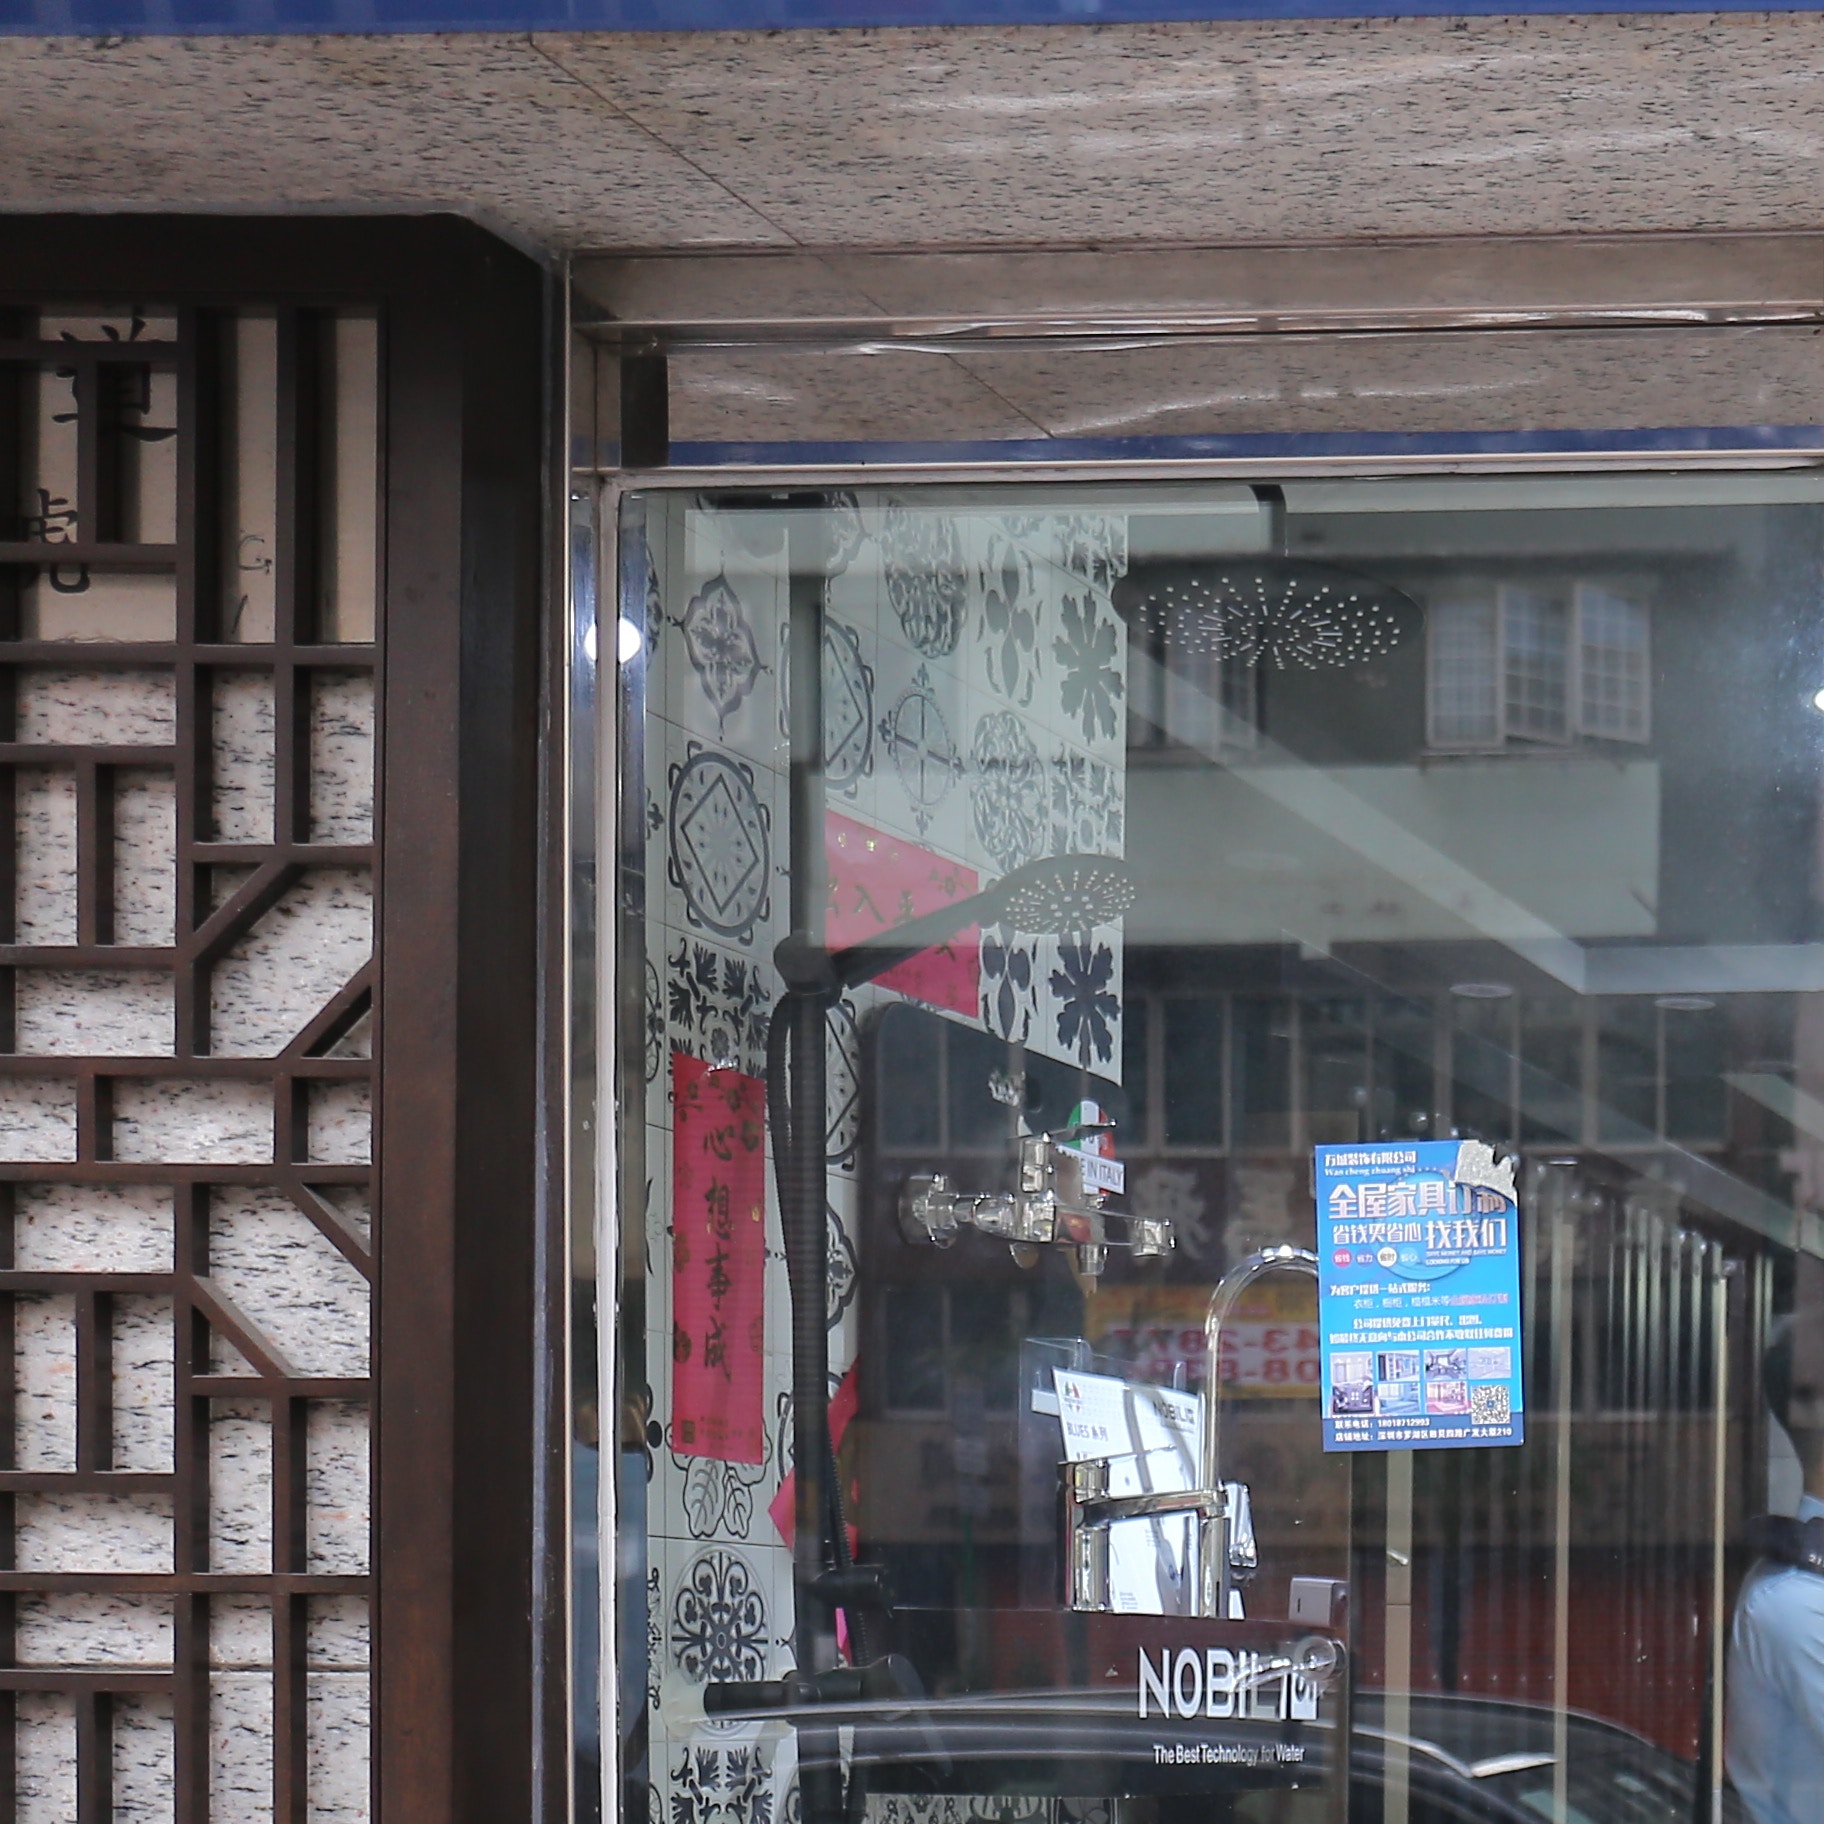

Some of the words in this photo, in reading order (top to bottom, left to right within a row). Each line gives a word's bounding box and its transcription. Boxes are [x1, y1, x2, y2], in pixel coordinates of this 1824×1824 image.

[703, 1124, 735, 1383] 心想事成
[1153, 1744, 1174, 1762] The
[1176, 1744, 1200, 1763] Best
[1201, 1744, 1259, 1765] Technology
[1261, 1745, 1275, 1763] for
[1277, 1744, 1305, 1763] Water
